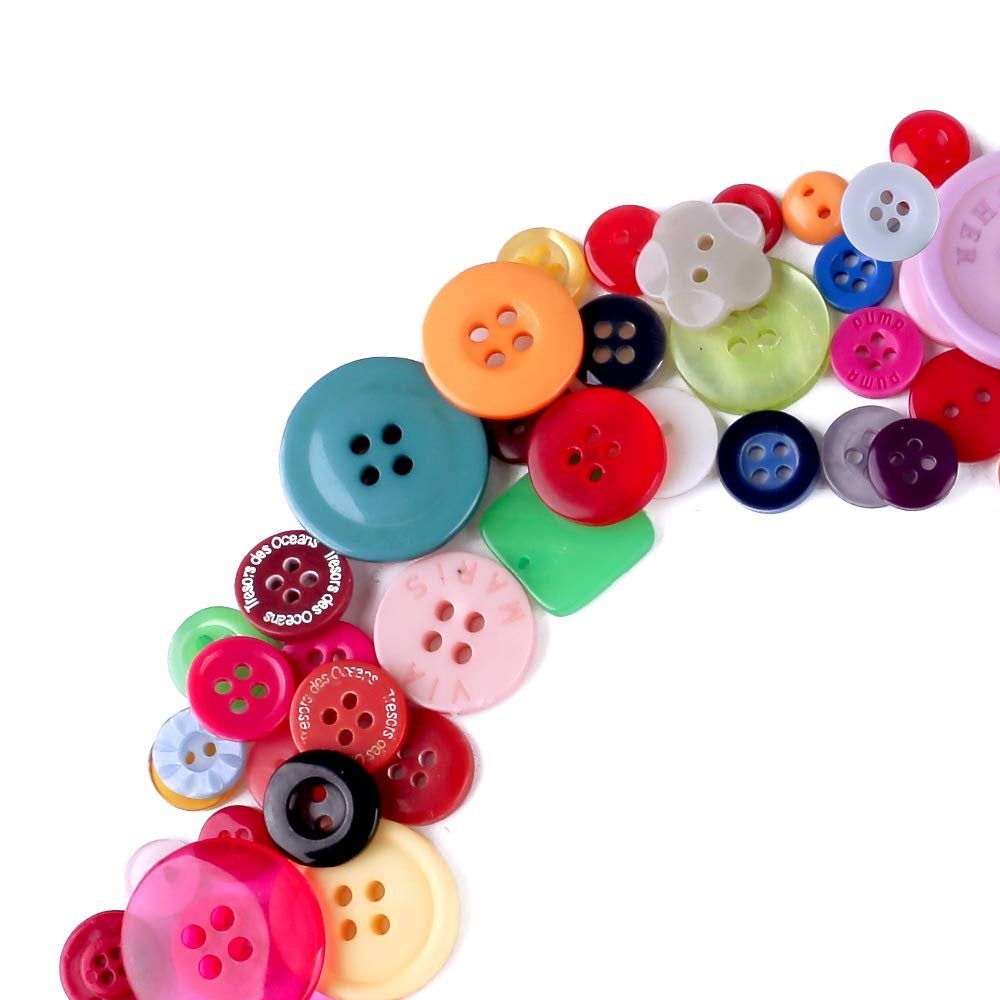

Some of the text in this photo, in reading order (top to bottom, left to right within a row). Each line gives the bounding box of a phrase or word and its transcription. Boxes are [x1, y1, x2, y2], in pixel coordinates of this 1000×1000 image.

[250, 544, 273, 566] des
[271, 533, 319, 550] Oceans
[311, 593, 334, 616] des
[404, 559, 526, 625] MARIS
[263, 610, 312, 627] Oceans
